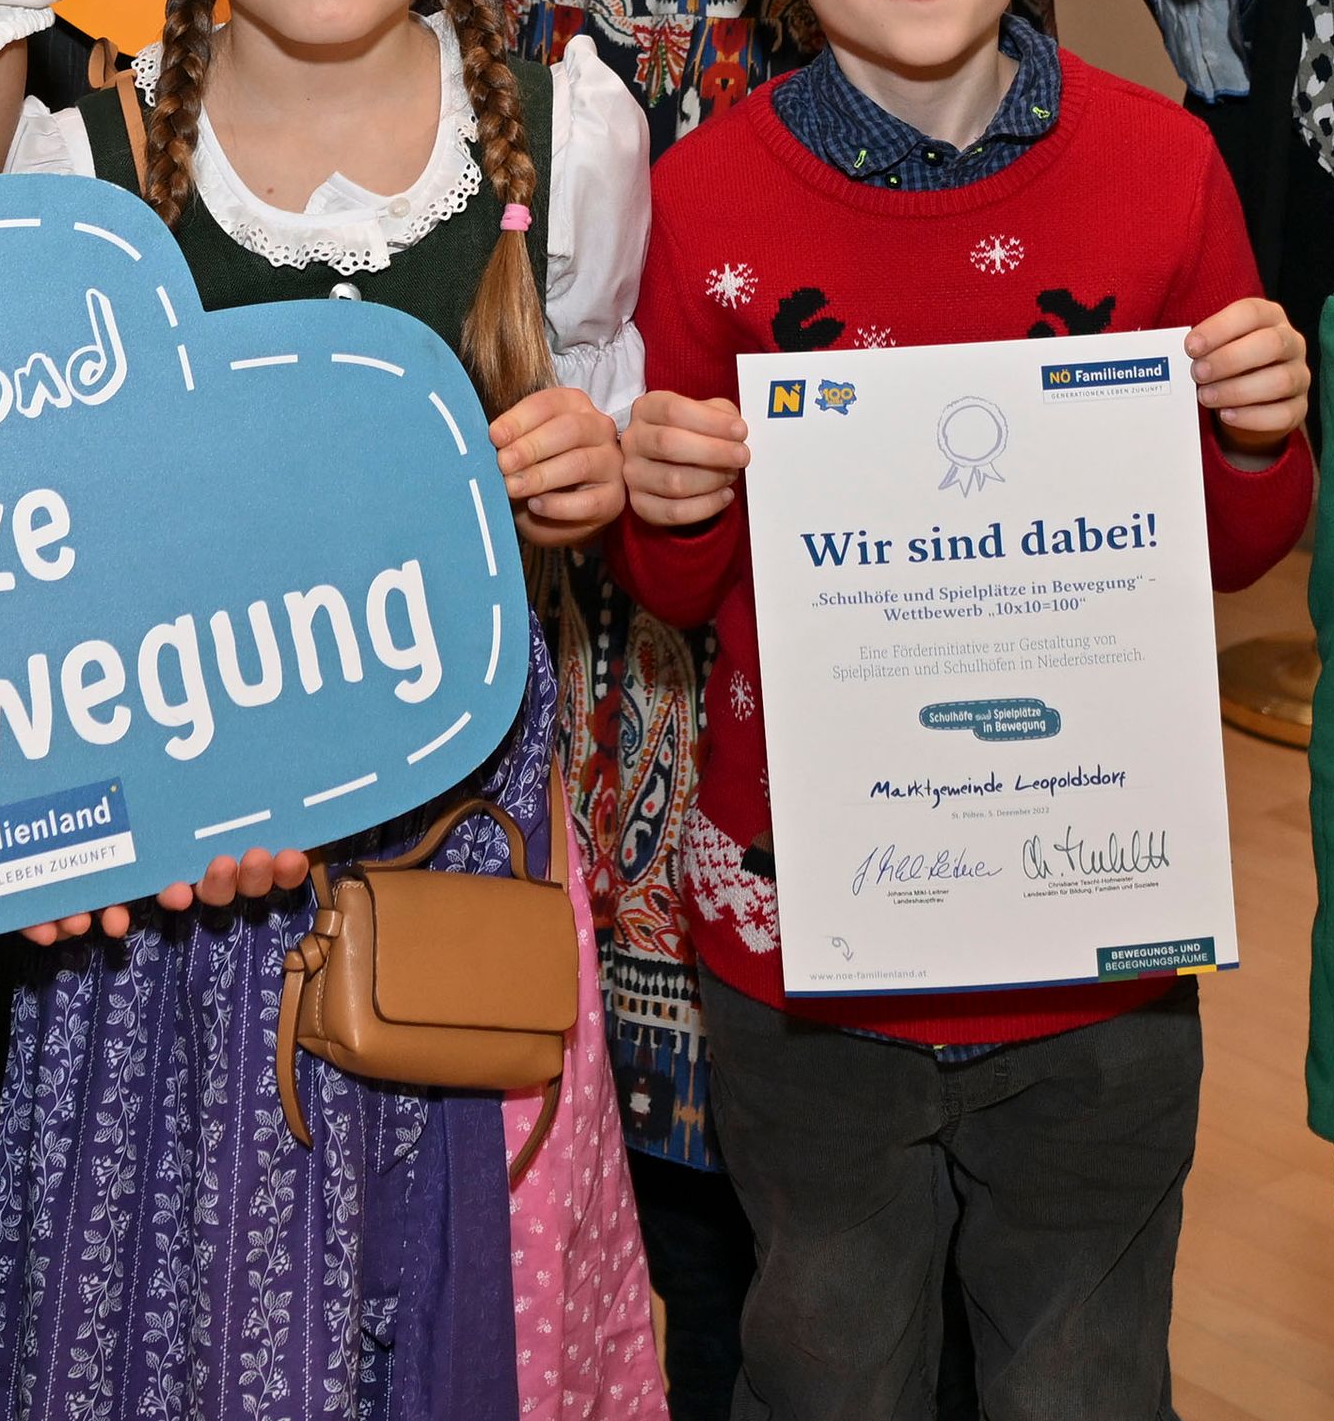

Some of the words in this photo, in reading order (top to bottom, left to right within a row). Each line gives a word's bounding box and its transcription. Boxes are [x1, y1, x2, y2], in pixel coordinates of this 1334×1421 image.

[1049, 368, 1071, 384] NÖ
[1075, 364, 1163, 383] Familienland
[773, 386, 800, 413] N
[823, 388, 853, 402] 100
[1051, 390, 1105, 400] GENERATIONEN
[1107, 388, 1129, 396] LEBEN
[1131, 385, 1163, 394] ZUKUNFT
[800, 529, 893, 567] Wir
[908, 522, 1007, 563] sind
[1021, 512, 1159, 557] dabei!
[812, 586, 899, 608] „Schulhöfe
[903, 587, 935, 603] und
[938, 579, 1027, 602] Spielplätze
[1031, 578, 1048, 595] in
[1052, 575, 1144, 594] Bewegung“
[883, 601, 984, 622] Wettbewerb
[988, 596, 1088, 619] „10x10=100“
[859, 646, 888, 661] Eine
[892, 640, 990, 660] Förderinitiative
[993, 641, 1016, 654] zur
[1019, 634, 1091, 653] Gestaltung
[1094, 633, 1117, 647] von
[832, 663, 911, 683] Spielplätzen
[914, 662, 940, 677] und
[943, 657, 1016, 675] Schulhöfen
[1021, 655, 1033, 671] in
[1037, 647, 1146, 669] Niederösterreich.
[929, 709, 973, 724] Schulhöfe
[993, 707, 1042, 722] Spielplätze
[983, 721, 993, 733] in
[995, 718, 1046, 734] Bewegung
[870, 772, 1004, 809] Marktgemeinde
[1015, 764, 1126, 797] Leopoldsdorf
[50, 844, 118, 873] ZUKUNFT
[1048, 880, 1079, 889] Christiane
[1060, 888, 1068, 896] für
[1095, 884, 1120, 893] Familien
[1121, 883, 1133, 891] und
[1134, 881, 1160, 889] Soziales
[1111, 947, 1178, 961] BEWEGUNGS-
[1180, 942, 1201, 954] UND
[1105, 952, 1209, 972] BEGEGNUNGSRÄUME
[809, 970, 928, 981] www.noe-familienland.at
